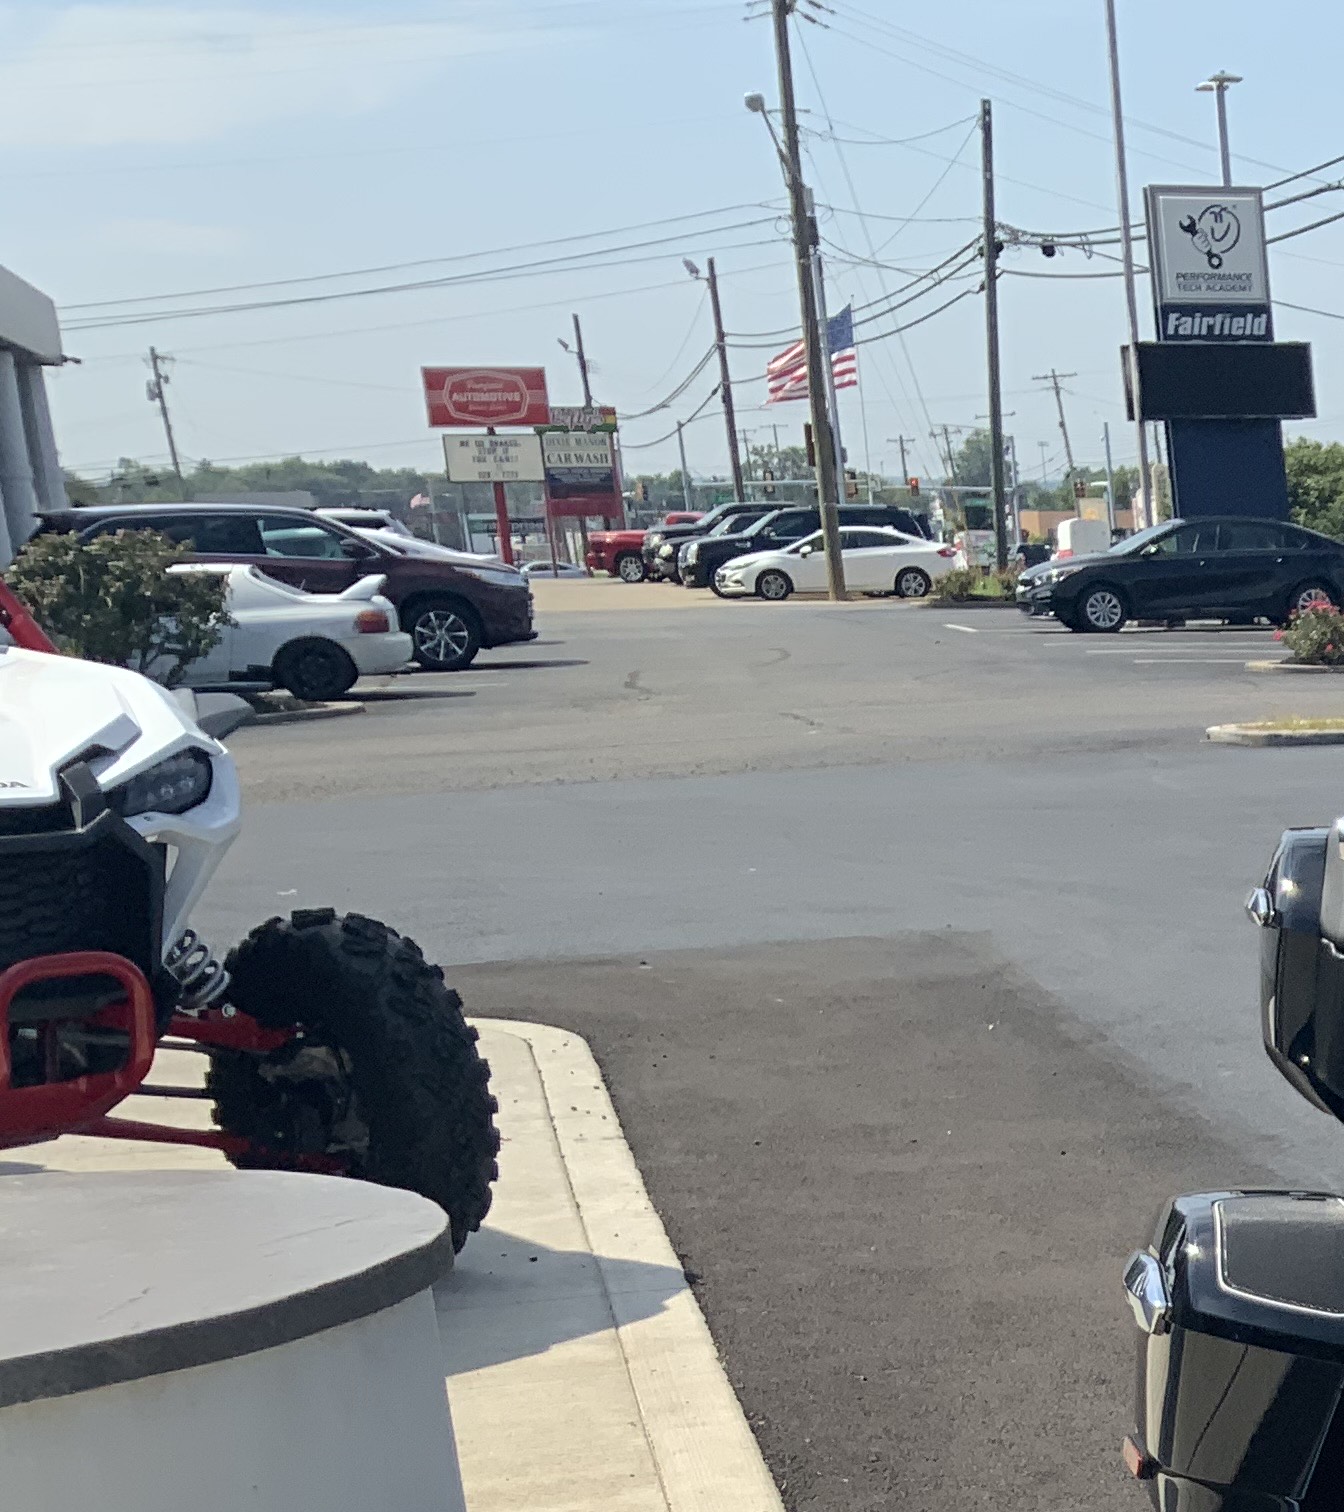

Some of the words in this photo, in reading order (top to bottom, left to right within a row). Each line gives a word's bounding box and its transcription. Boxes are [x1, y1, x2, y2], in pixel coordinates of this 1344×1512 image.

[1176, 272, 1253, 281] PERFORMANCE
[1178, 283, 1202, 292] TECH
[1206, 283, 1253, 292] ACADEMY
[1167, 312, 1268, 336] Fairfield
[547, 453, 571, 464] CAR
[574, 453, 609, 464] WASH
